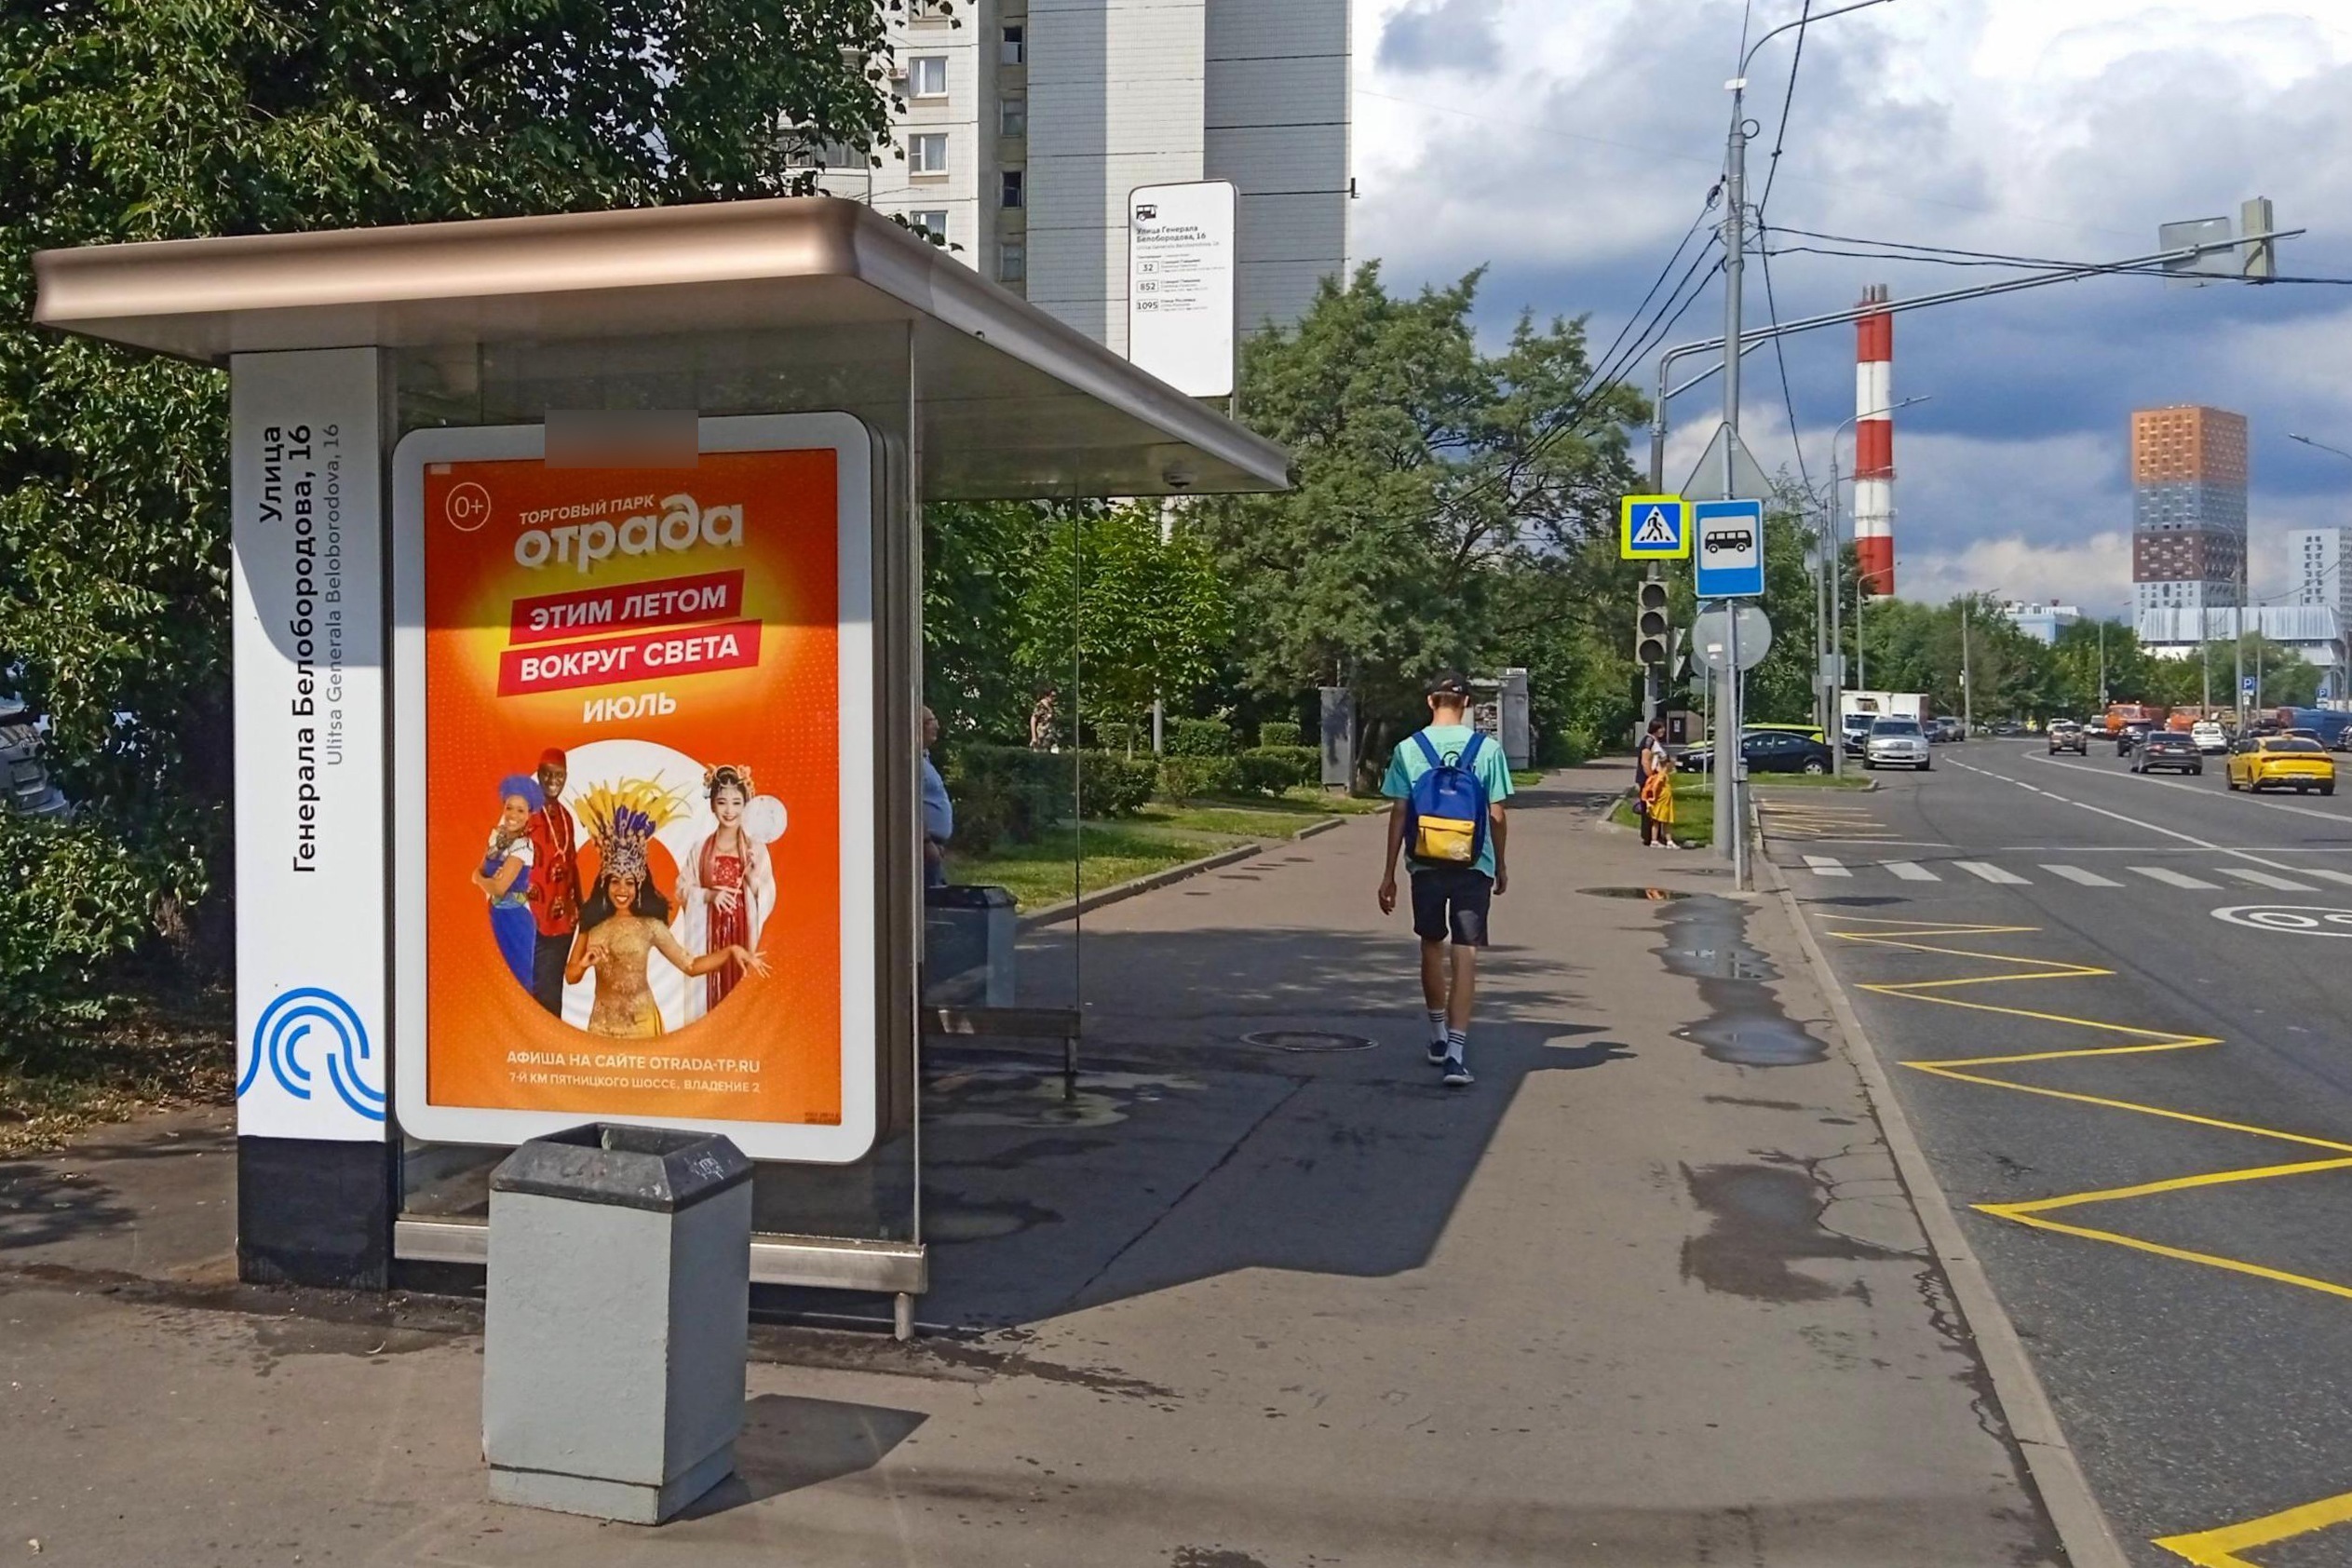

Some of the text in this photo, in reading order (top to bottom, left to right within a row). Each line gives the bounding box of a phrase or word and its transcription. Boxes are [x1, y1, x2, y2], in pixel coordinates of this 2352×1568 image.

[1196, 232, 1206, 240] 16
[1137, 301, 1158, 310] 1095
[259, 426, 284, 523] Улица
[454, 496, 484, 518] 0+
[519, 493, 656, 525] ТОРГОВЫЙ ПАРК
[514, 493, 744, 574] отрада
[323, 424, 343, 765] Ulitsa Generala Beloborodova, 16
[529, 585, 727, 632] ЭТИМ ЛЕТОМ
[288, 425, 320, 872] Генерала Белобородова, 16
[520, 634, 740, 683] ВОКРУГ СВЕТА
[583, 692, 677, 723] ИЮЛЬ
[507, 1050, 761, 1074] АФИША НА САЙТЕ OTRADA-TP.RU
[530, 1073, 548, 1084] КМ
[549, 1074, 629, 1088] ПЯТНИЦКОГО
[631, 1076, 681, 1090] ШОССЕ,
[683, 1079, 750, 1093] ВЛАДЕНИЕ
[751, 1082, 761, 1093] 2
